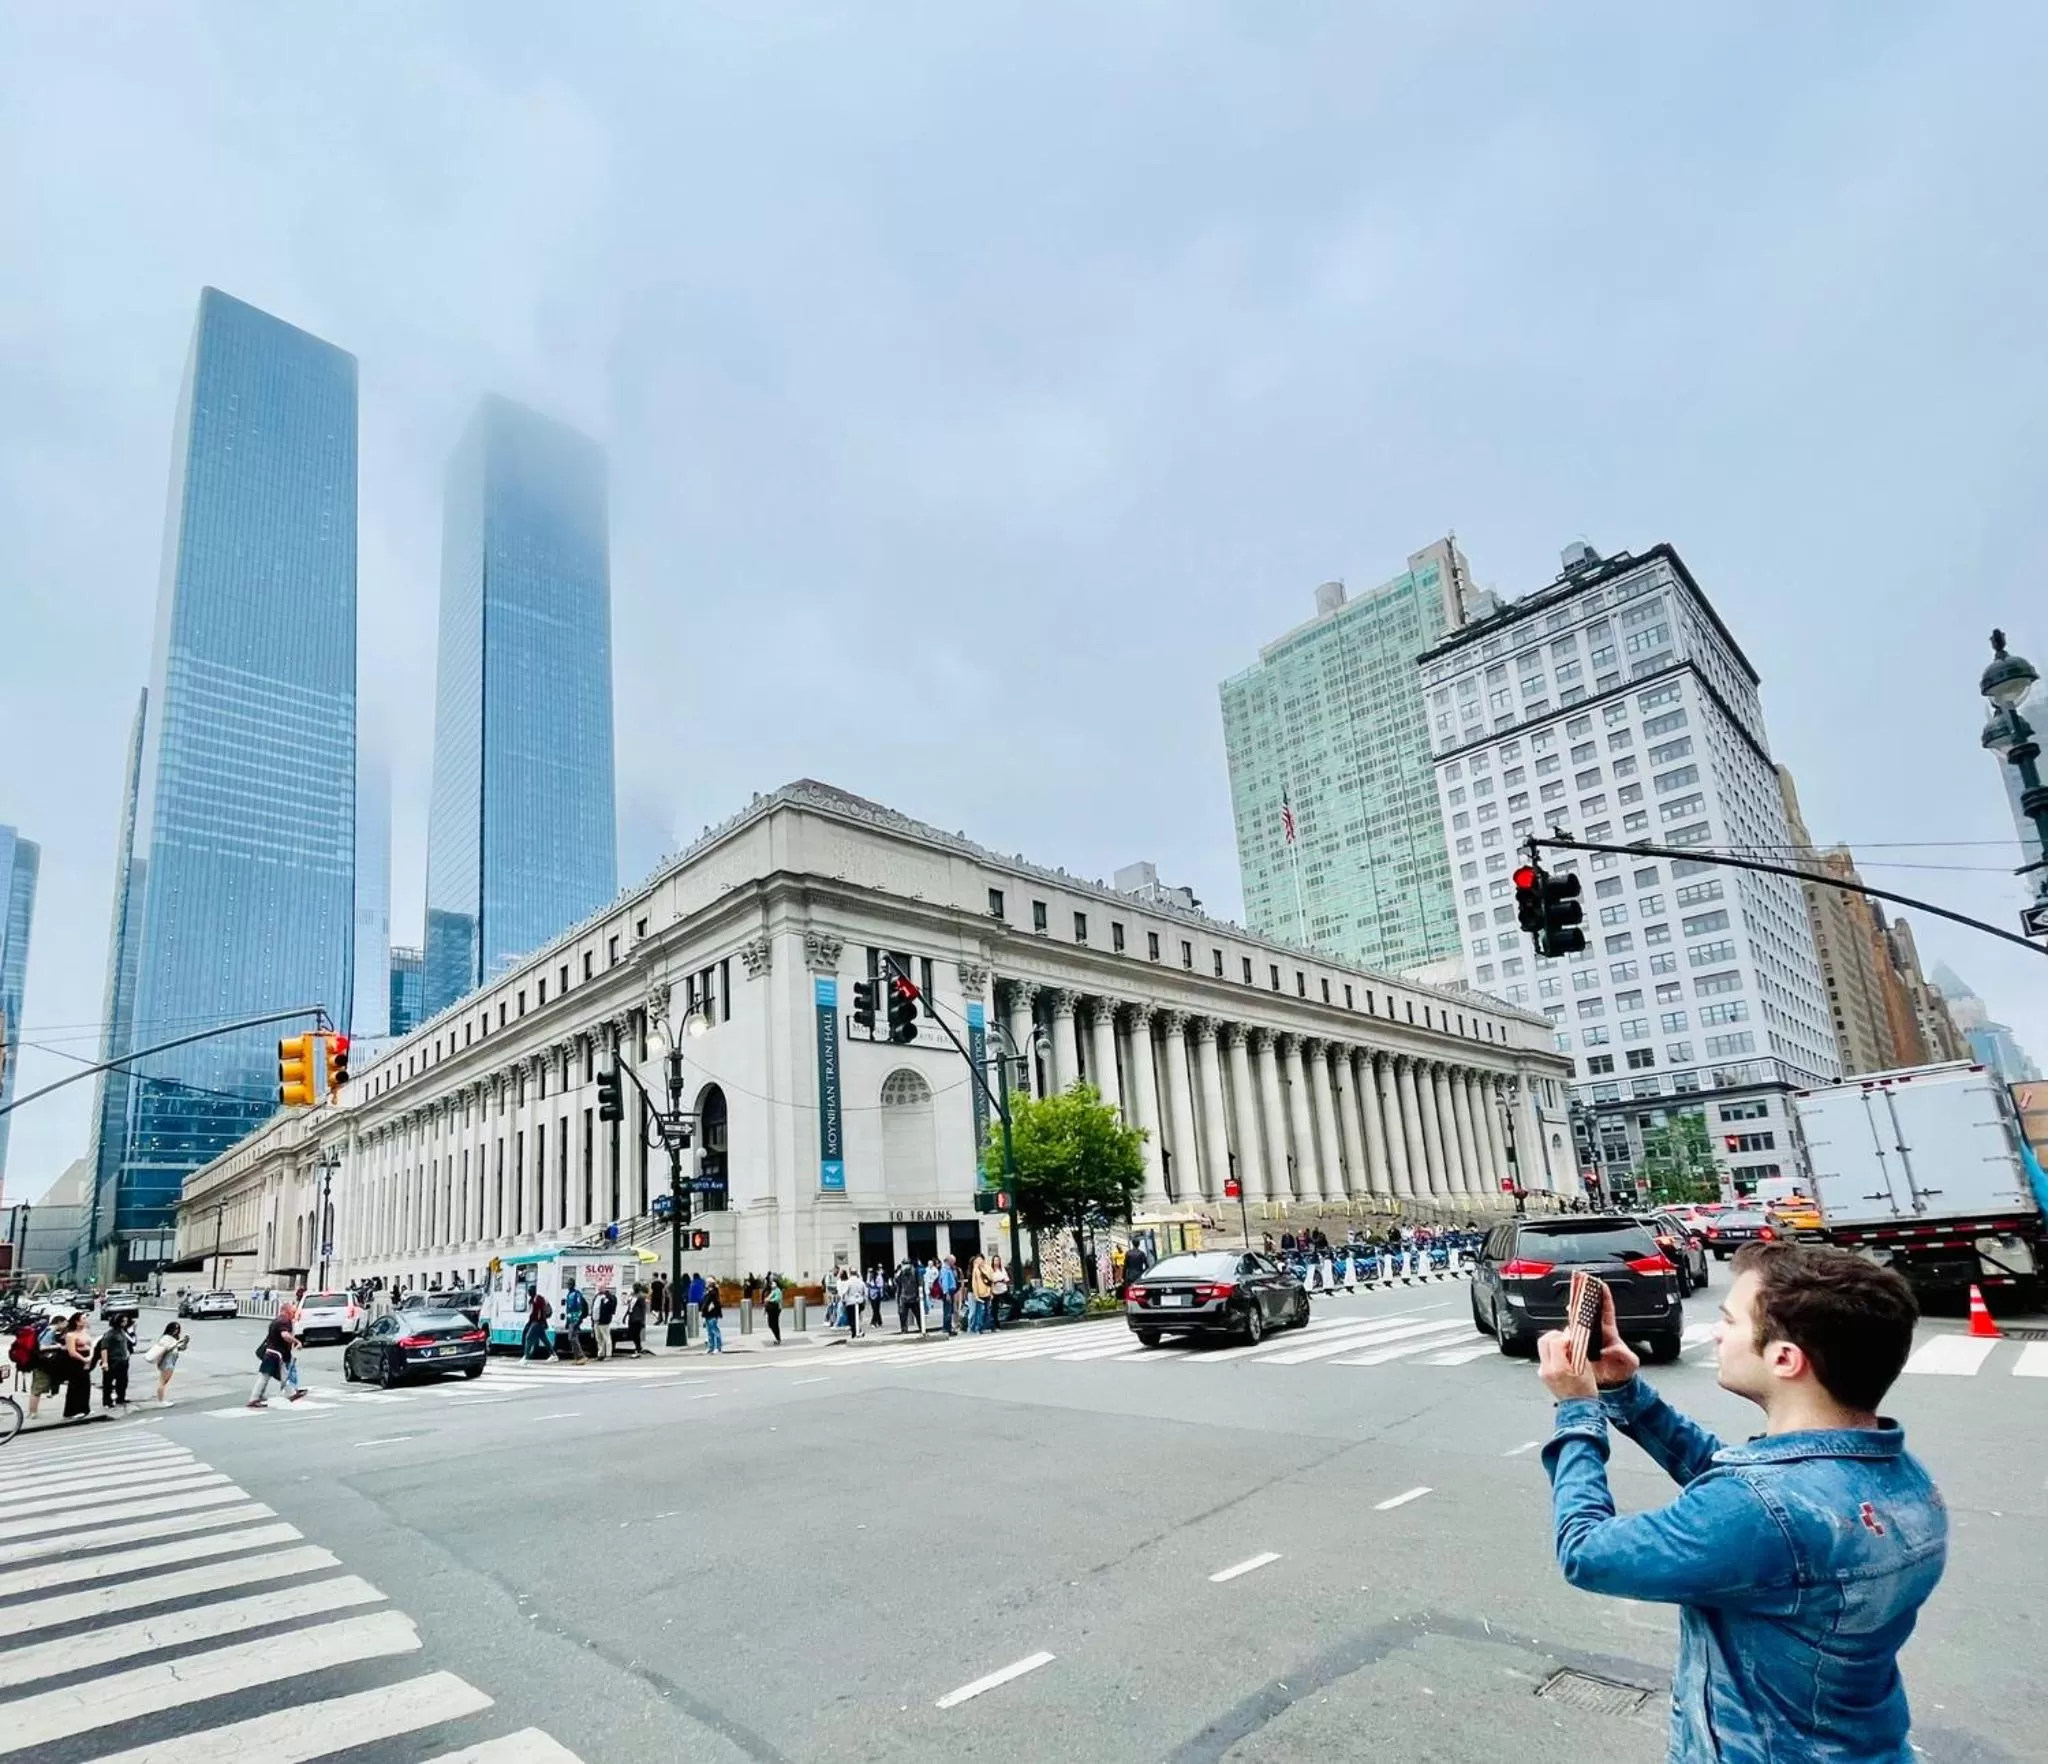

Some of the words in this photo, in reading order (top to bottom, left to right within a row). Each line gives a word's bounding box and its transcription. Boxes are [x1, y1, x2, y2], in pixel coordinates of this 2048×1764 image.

[823, 1012, 833, 1042] HALL
[825, 1045, 835, 1081] TRAIN
[826, 1085, 838, 1155] MOYNIHAN
[889, 1210, 903, 1221] TO
[911, 1210, 953, 1221] TRAINS
[585, 1264, 614, 1273] SLOW
